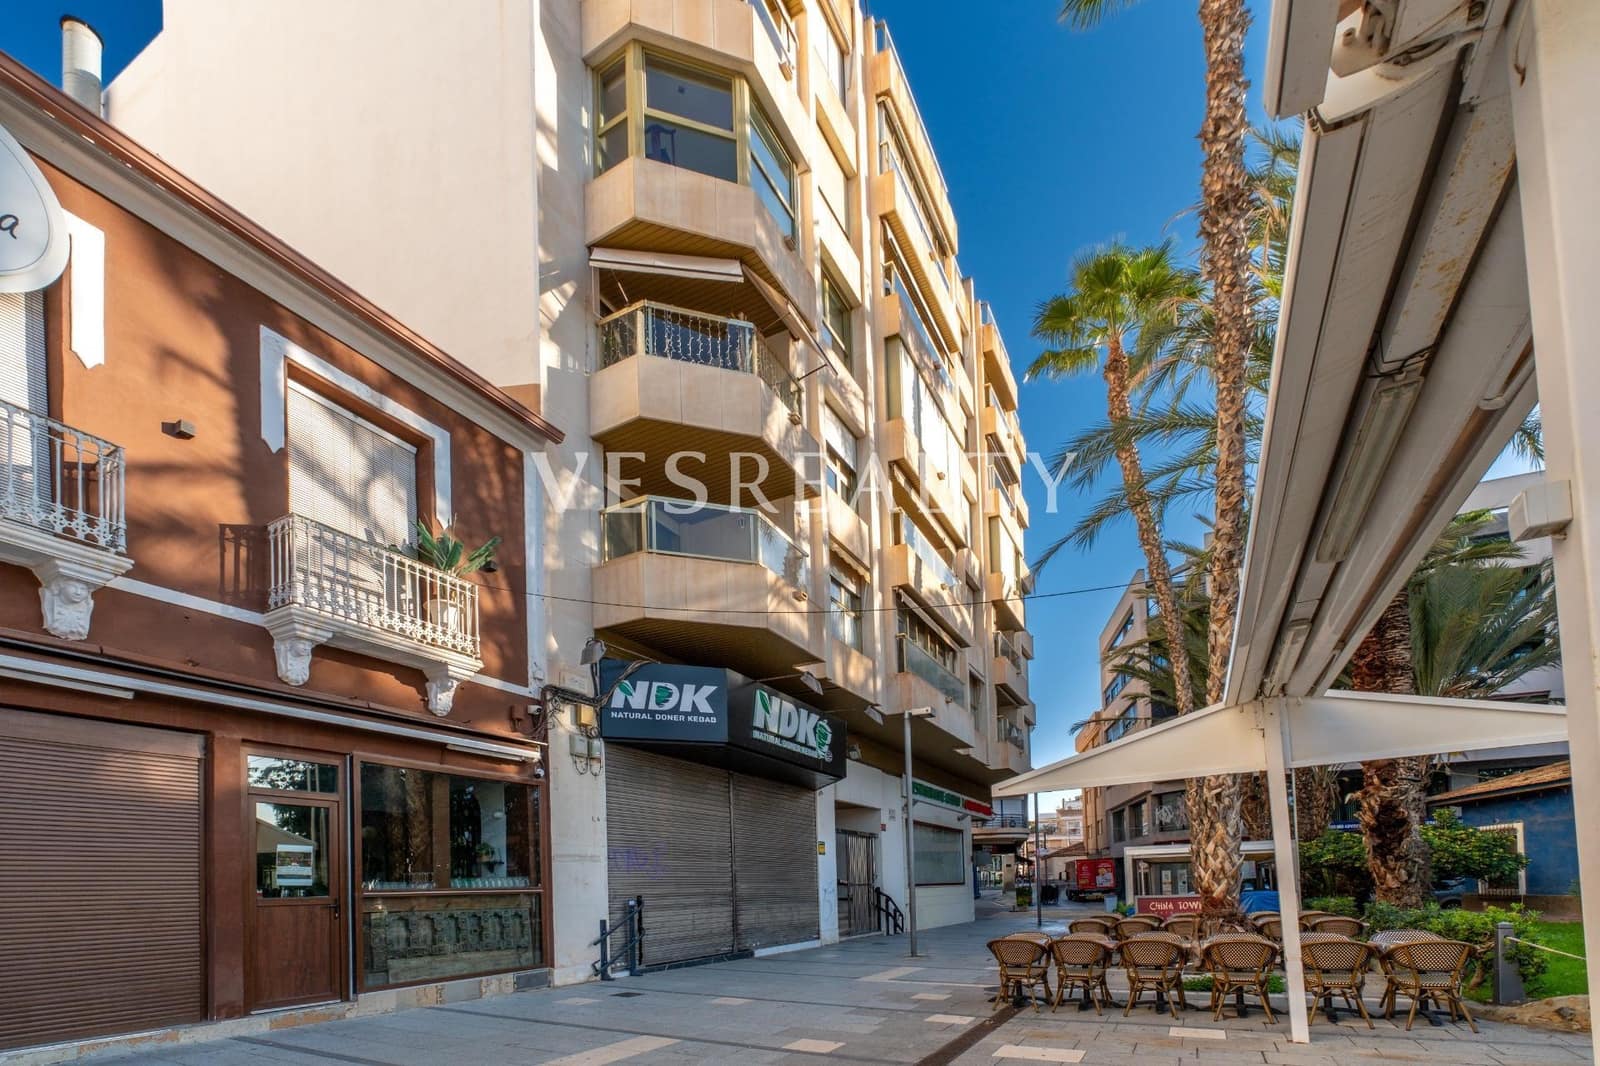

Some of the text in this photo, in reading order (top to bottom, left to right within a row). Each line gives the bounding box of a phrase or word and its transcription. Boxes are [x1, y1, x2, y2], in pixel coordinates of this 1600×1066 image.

[611, 680, 718, 714] NDK
[610, 711, 717, 723] NATURAL DONER KEBAB
[752, 689, 820, 748] NDK
